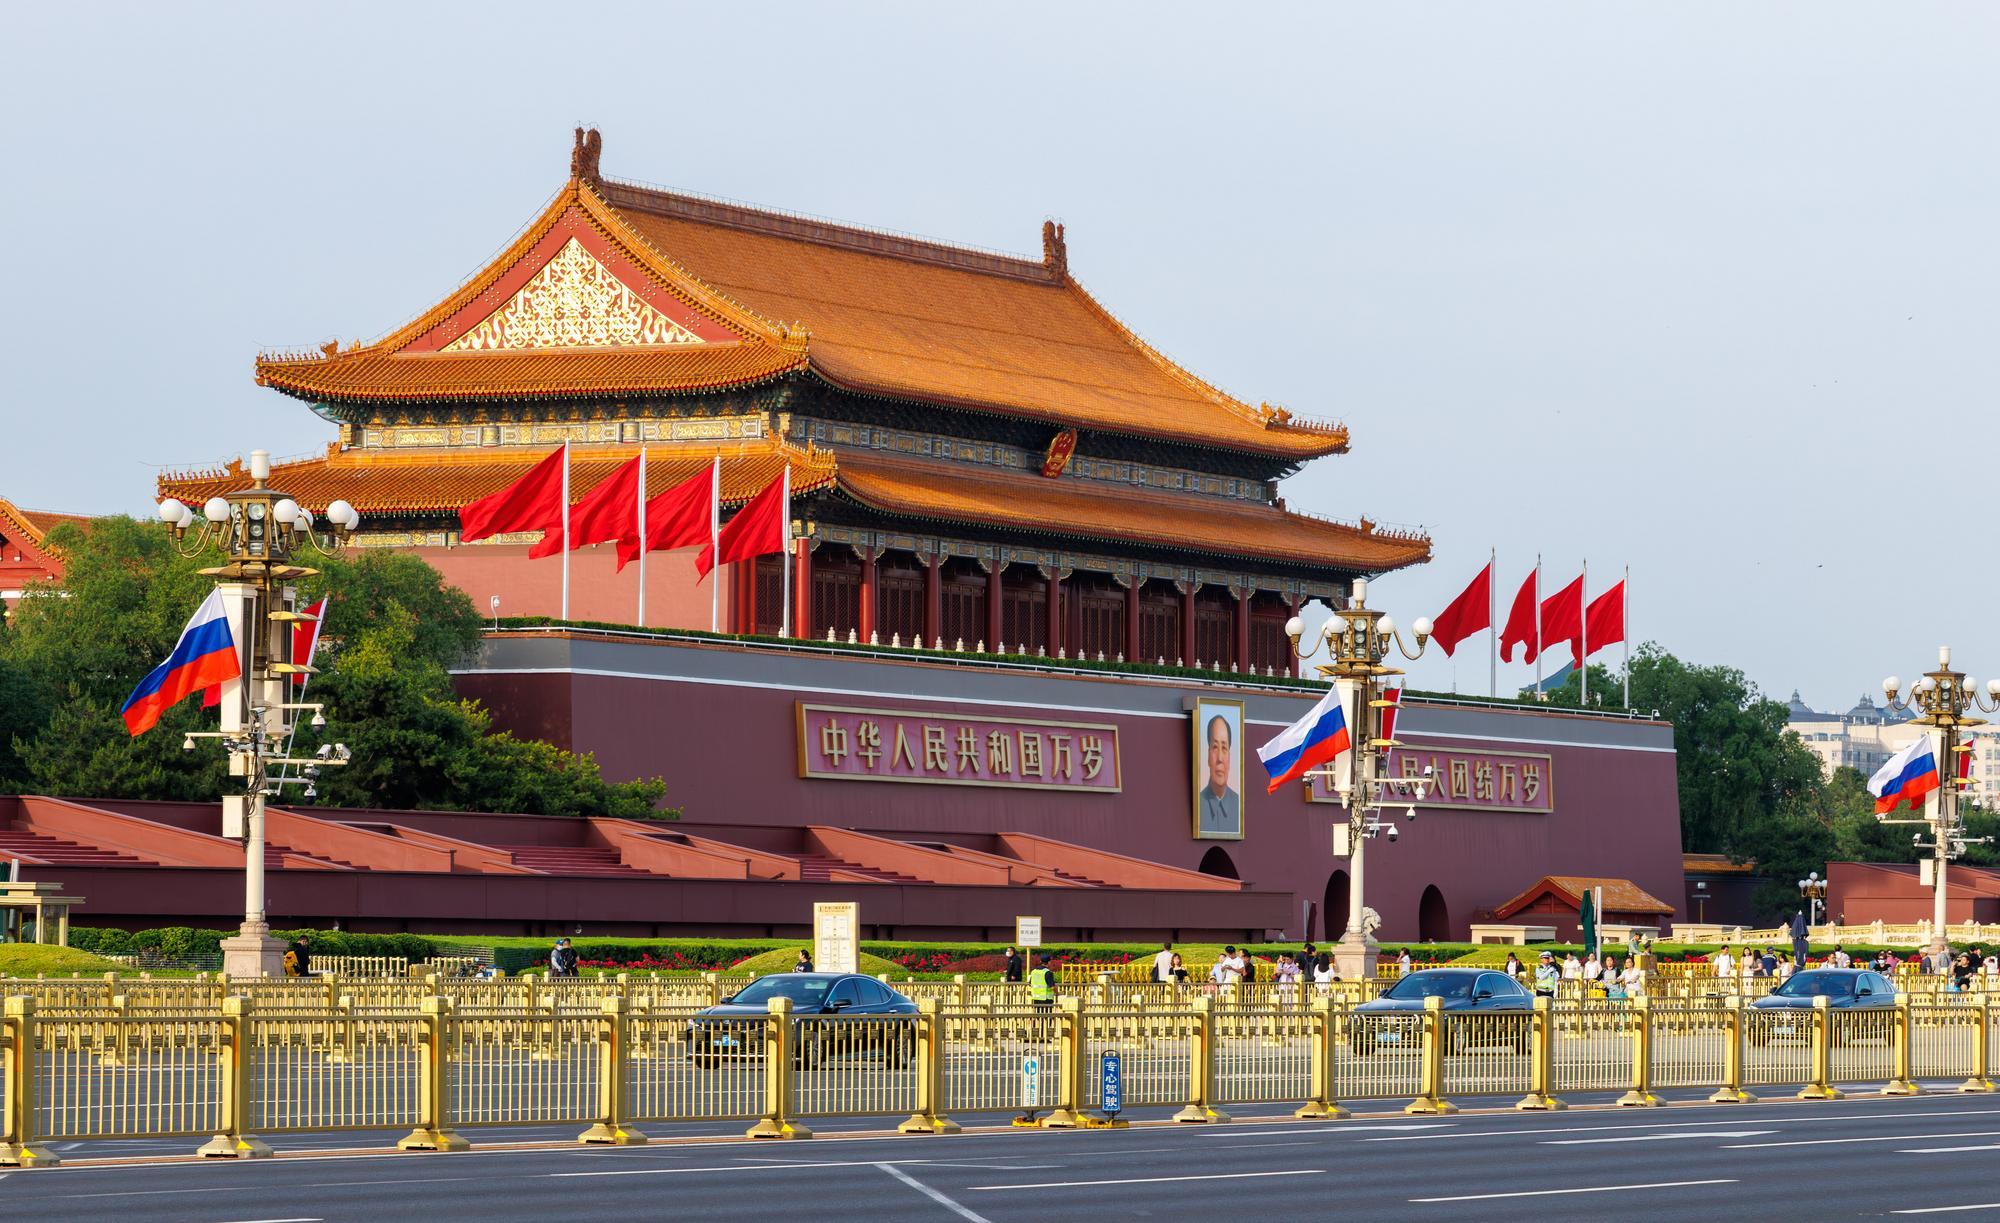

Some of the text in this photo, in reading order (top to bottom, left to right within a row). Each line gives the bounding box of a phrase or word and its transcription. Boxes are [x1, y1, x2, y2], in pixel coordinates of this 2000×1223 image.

[822, 719, 1105, 780] 中华人民共和国万岁
[1105, 1061, 1118, 1107] 专心驾驶
